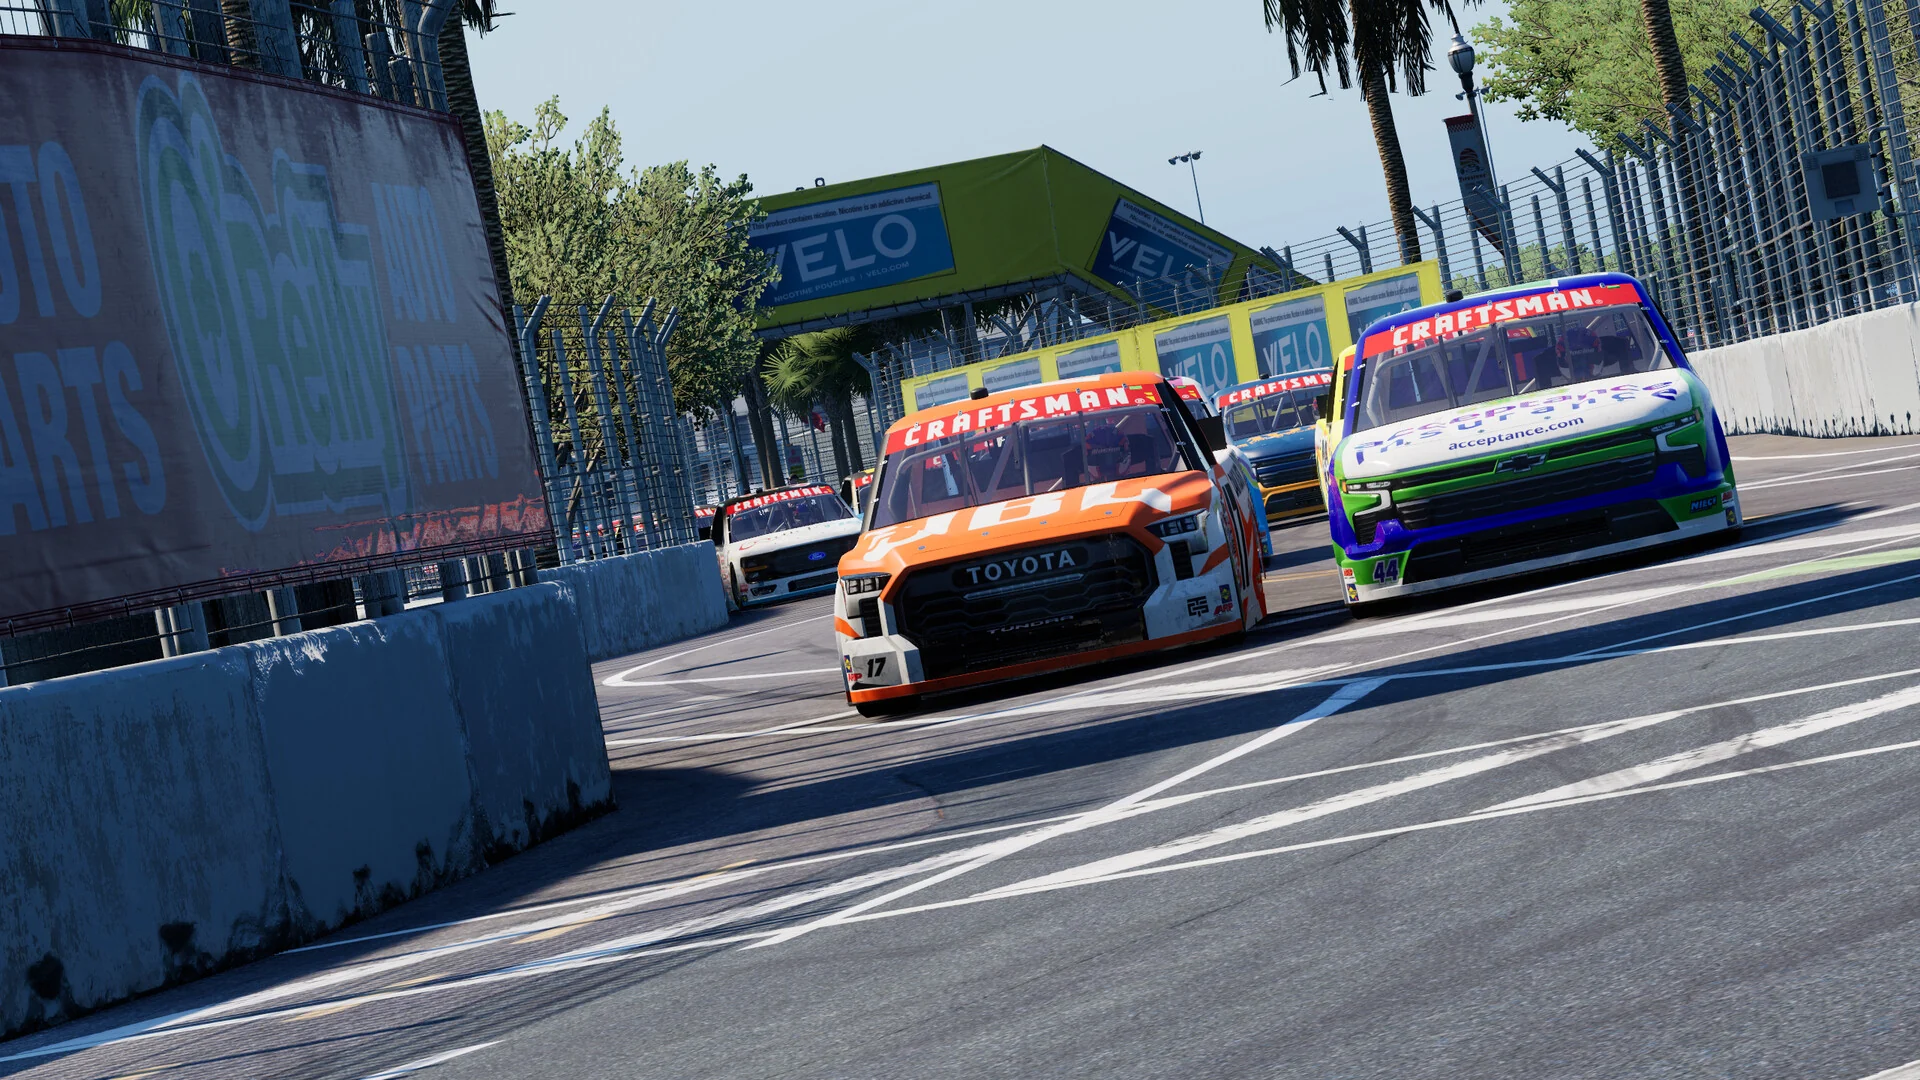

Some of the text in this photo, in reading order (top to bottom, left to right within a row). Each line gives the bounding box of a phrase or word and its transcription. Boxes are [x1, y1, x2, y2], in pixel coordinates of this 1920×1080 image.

[752, 222, 765, 231] This
[765, 217, 788, 231] product
[788, 212, 813, 225] contains
[838, 204, 863, 216] Nicotine
[878, 196, 904, 209] addictive
[372, 182, 457, 323] AUTO
[815, 276, 856, 292] POUCHES
[866, 261, 910, 279] VELO.COM
[1392, 289, 1594, 346] CRAFTSMAN
[1228, 373, 1332, 403] CRAFTSMA
[396, 343, 500, 485] PARTS
[904, 387, 1129, 446] CRAFTSMAN
[0, 339, 167, 536] ARTS
[1448, 416, 1584, 451] acceptance.com
[733, 485, 822, 512] CRAFTSMAN
[966, 549, 1076, 585] TOYOTA
[1373, 558, 1399, 584] 44
[867, 656, 886, 678] 17
